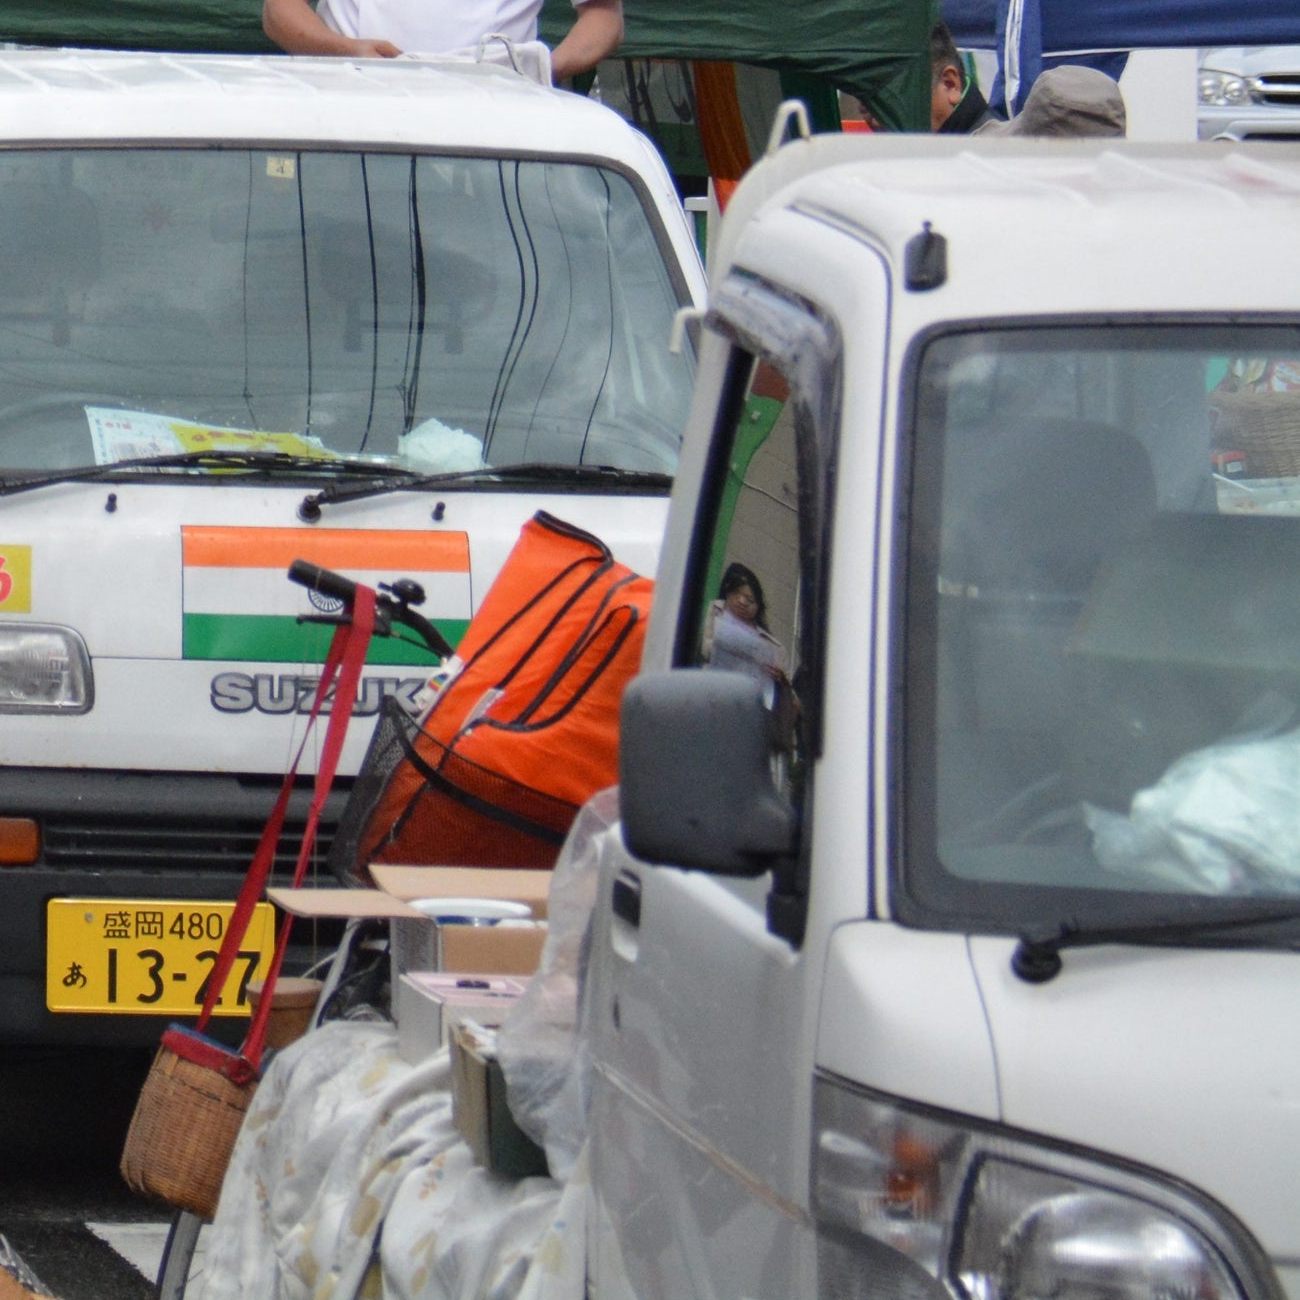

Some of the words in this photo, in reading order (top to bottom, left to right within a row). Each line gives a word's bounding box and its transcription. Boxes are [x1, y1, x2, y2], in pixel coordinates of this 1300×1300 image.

[210, 671, 426, 718] SUZUK
[103, 910, 164, 940] 盛岡
[168, 911, 223, 941] 480
[62, 961, 88, 989] あ
[107, 948, 262, 1006] 13-27
